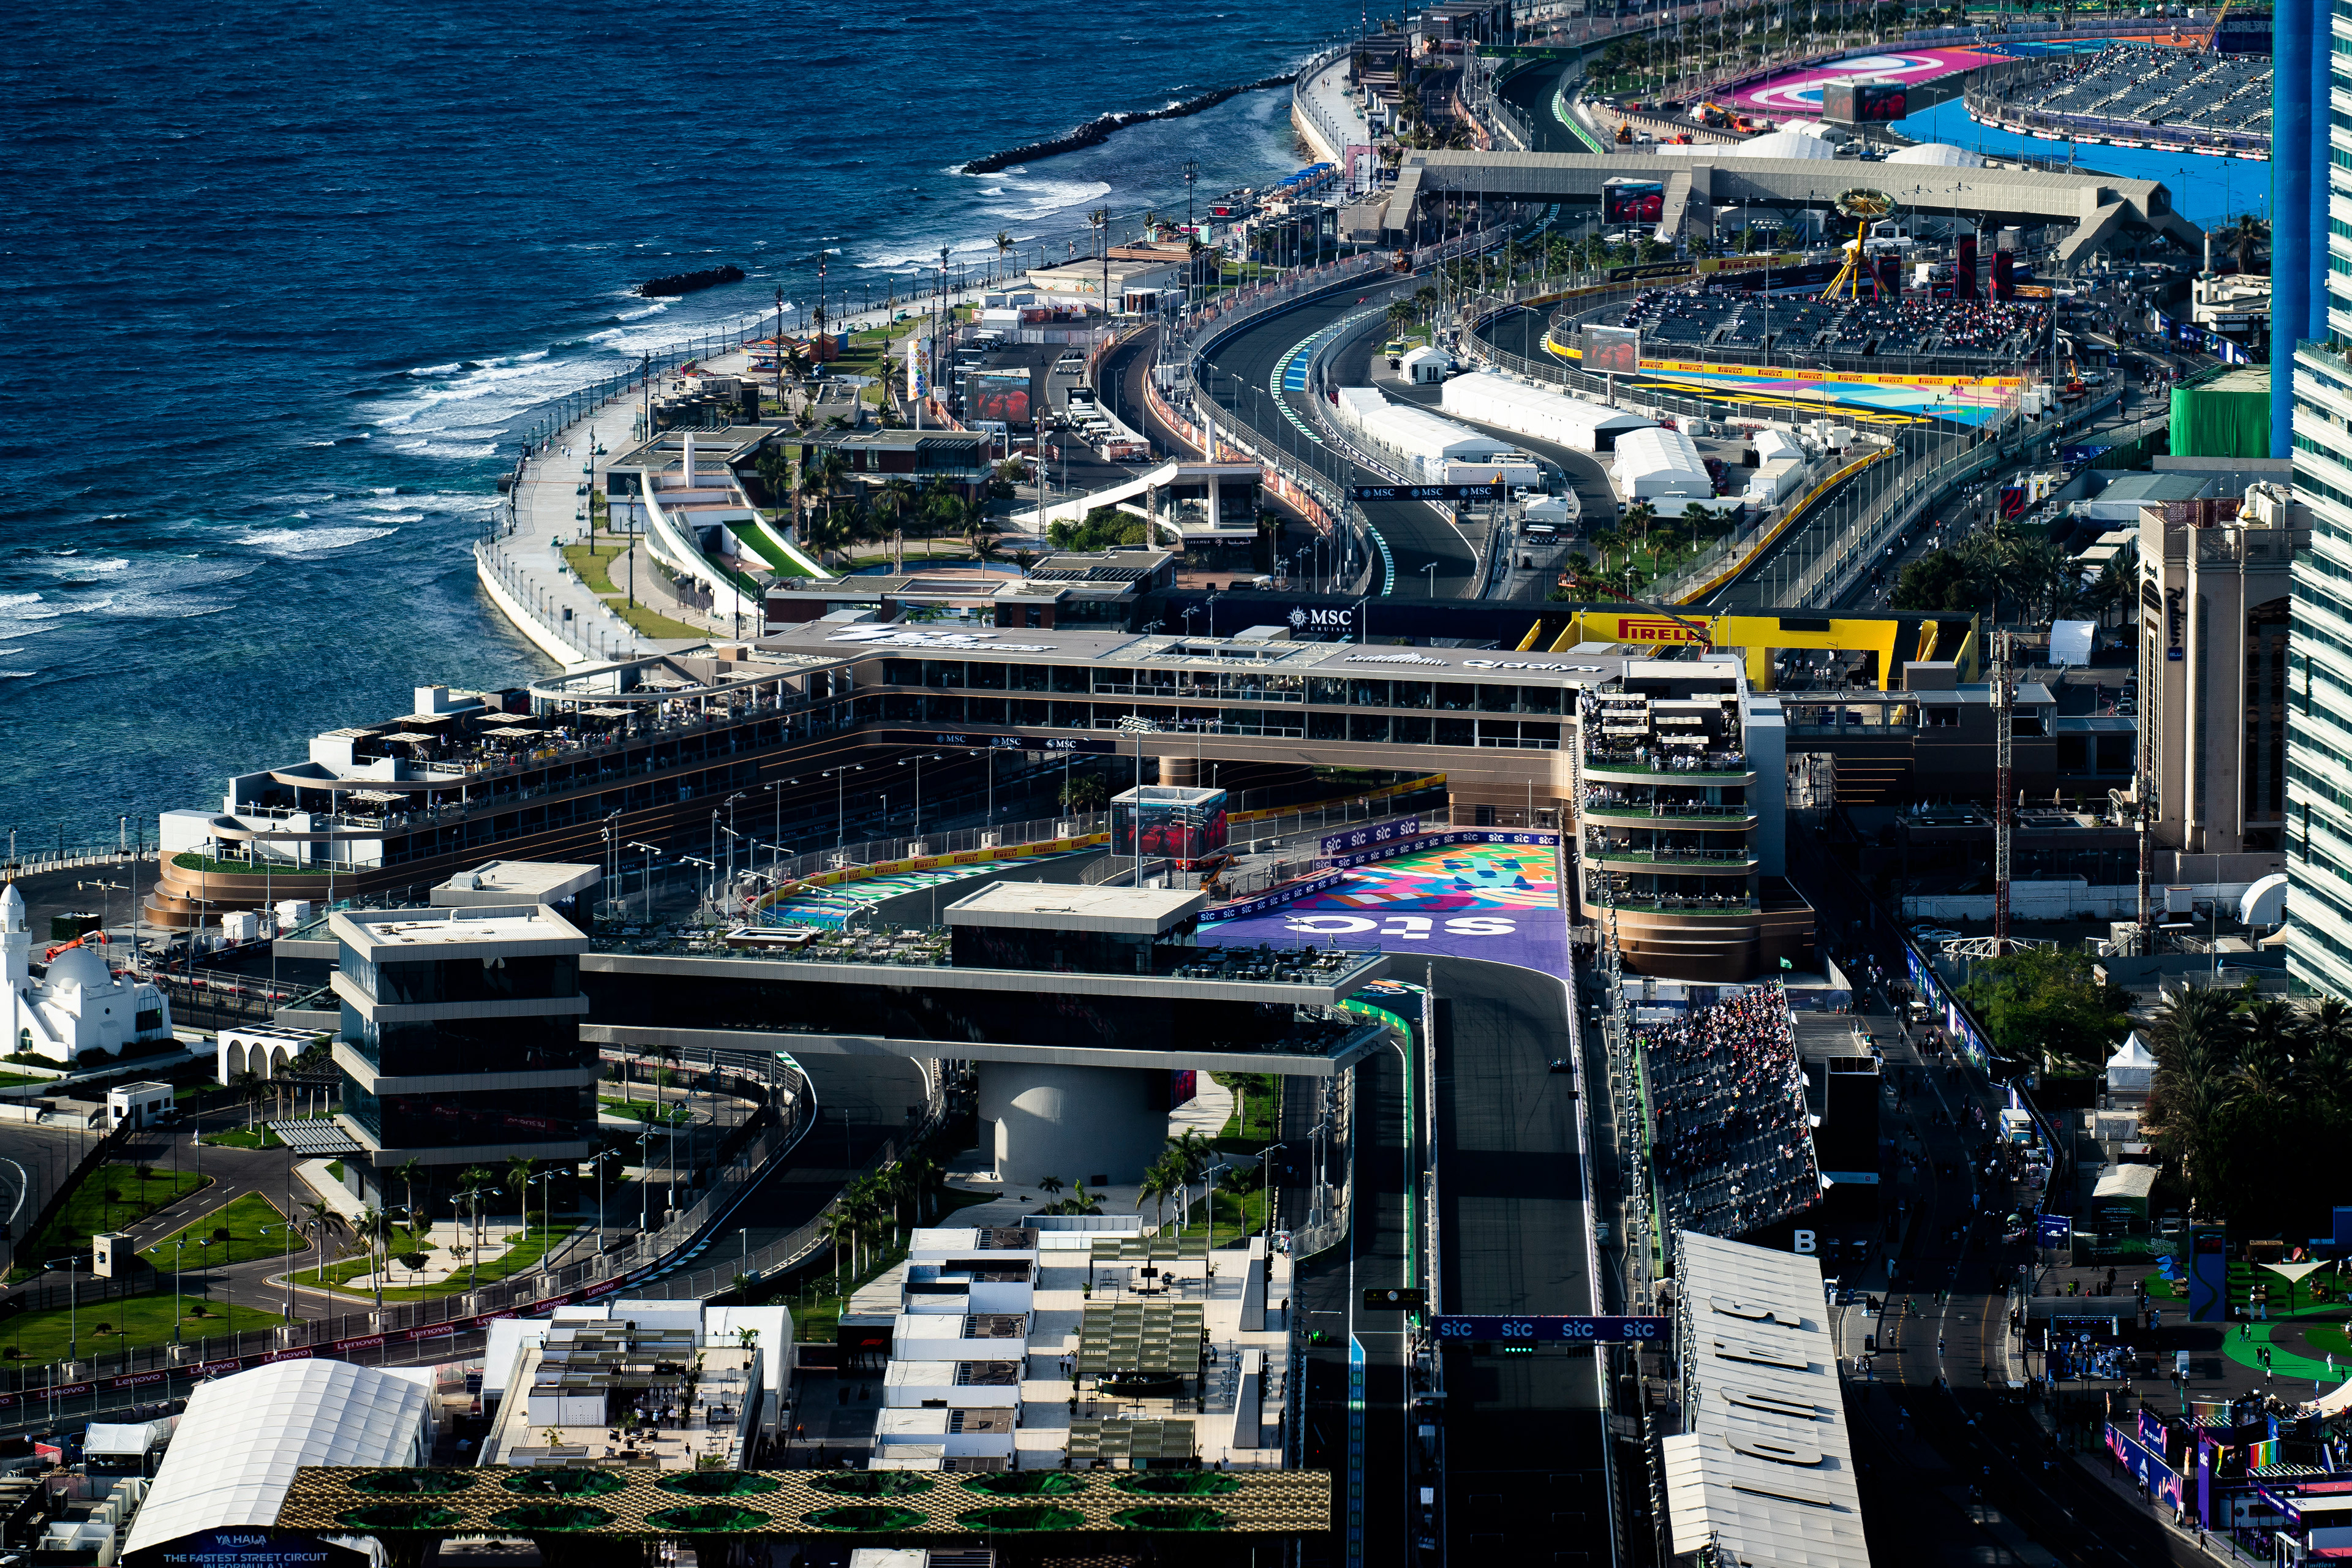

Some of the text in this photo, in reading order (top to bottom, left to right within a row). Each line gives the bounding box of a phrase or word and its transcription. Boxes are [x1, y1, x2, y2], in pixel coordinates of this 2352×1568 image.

[1634, 264, 1692, 276] ZERO
[1311, 609, 1351, 625] MSC
[1463, 659, 1602, 673] Qiddiya
[1056, 740, 1076, 748] MSC
[1376, 826, 1390, 841] stc
[1400, 821, 1415, 835] stc
[1071, 837, 1089, 848] PIRELLI
[1327, 837, 1341, 851] stc
[1351, 832, 1366, 846] stc
[993, 848, 1017, 858] PIRELLI
[1033, 843, 1057, 853] PIRELLI
[1316, 832, 1554, 869] stc stc stc stc stc stc stc stc stc stc stc stc stc
[914, 858, 938, 869] PIRELLI
[954, 853, 978, 863] PIRELLI
[875, 863, 899, 874] PIRELLI
[839, 869, 861, 881] PIRELLI
[1224, 908, 1235, 918] stc
[1242, 905, 1252, 914] stc
[1200, 912, 1215, 921] stc
[1795, 1230, 1816, 1253] B
[587, 1283, 614, 1296] Lenovo
[536, 1298, 568, 1311] Lenovo
[410, 1325, 451, 1338] Lenovo
[1441, 1320, 1472, 1336] stc
[1502, 1321, 1532, 1336] stc
[1562, 1321, 1593, 1336] stc
[1623, 1321, 1654, 1336] stc
[337, 1337, 382, 1349] Lenovo
[190, 1362, 235, 1374] Lenovo
[115, 1374, 160, 1386] Lenovo
[2199, 1452, 2208, 1467] stc
[164, 1553, 328, 1562] THE FASTEST STREET CIRCUIT
